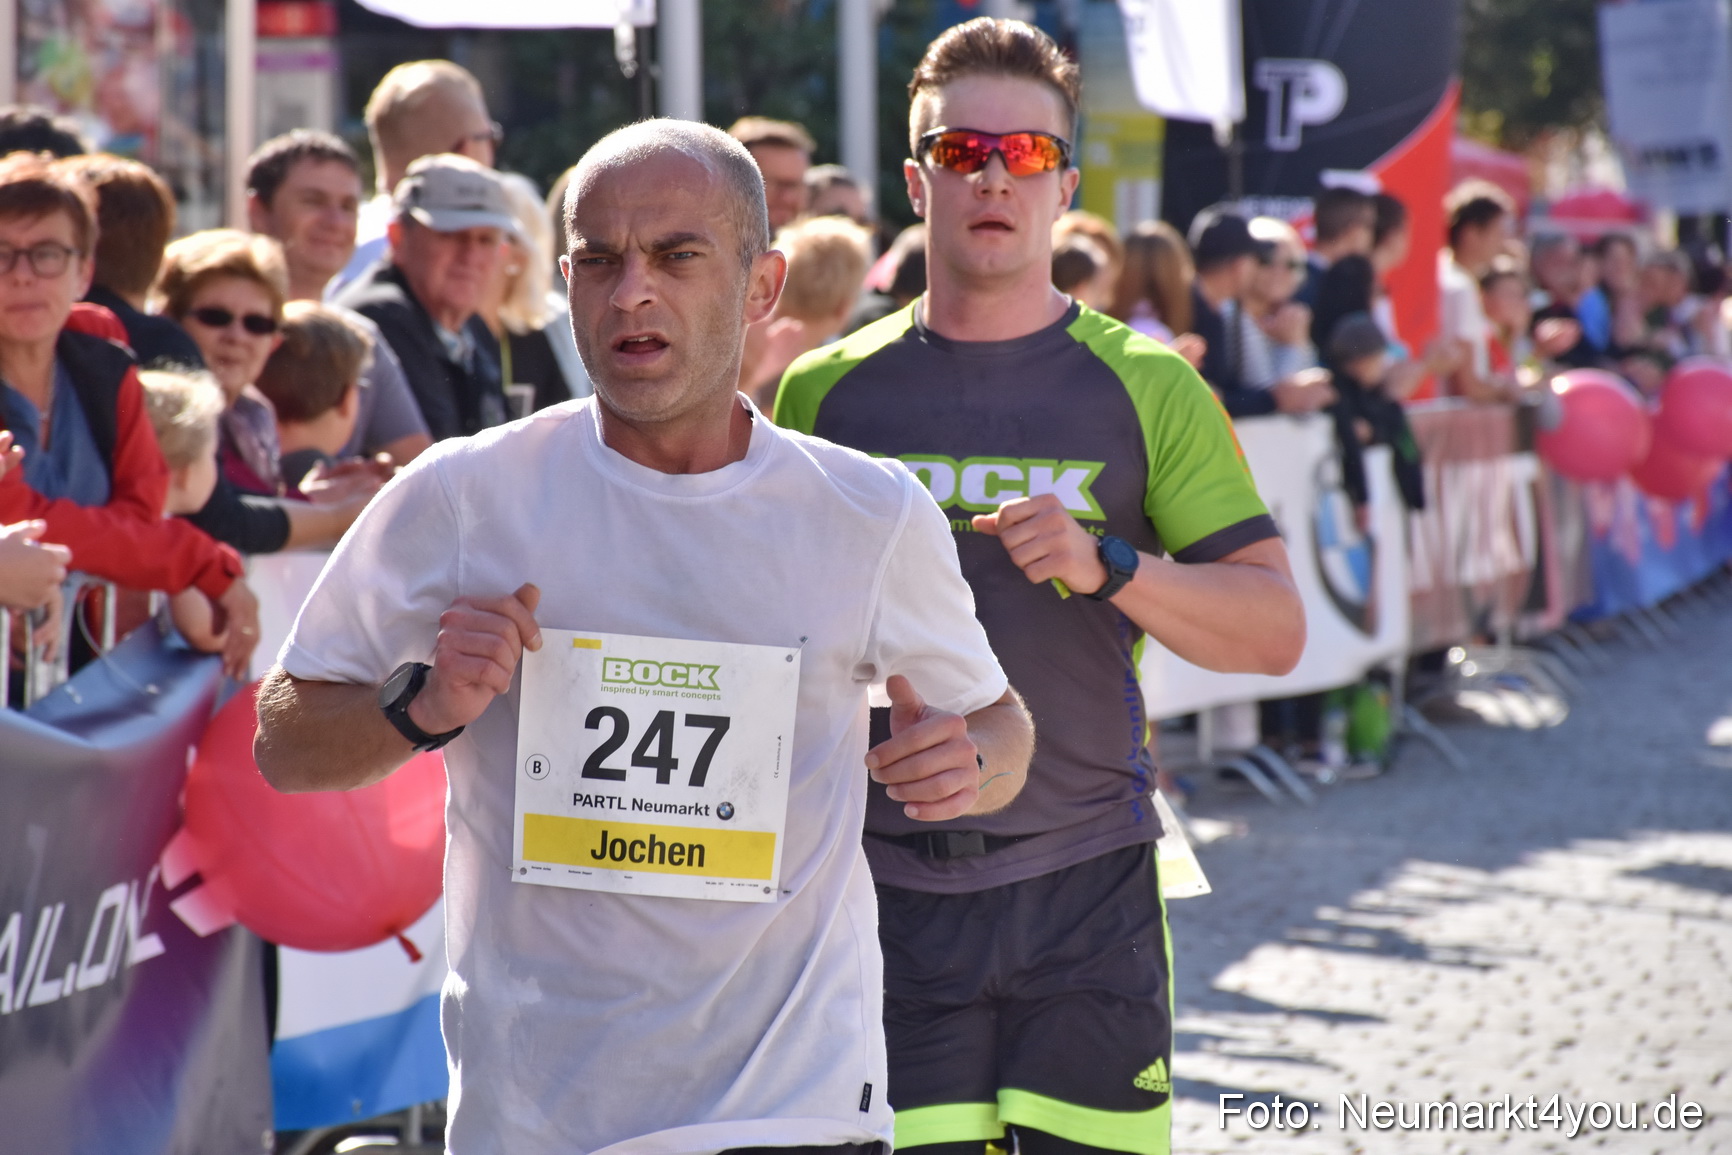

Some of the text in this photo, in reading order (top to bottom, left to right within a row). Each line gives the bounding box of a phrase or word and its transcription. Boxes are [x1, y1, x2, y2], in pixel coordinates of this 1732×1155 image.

[868, 453, 1106, 521] OCK
[602, 657, 720, 691] BOCK
[600, 683, 722, 701] inspired by smart concepts
[581, 705, 731, 787] 247
[533, 760, 541, 774] B
[573, 793, 627, 810] PARTL
[631, 797, 710, 817] Neumarkt
[590, 830, 706, 868] Jochen
